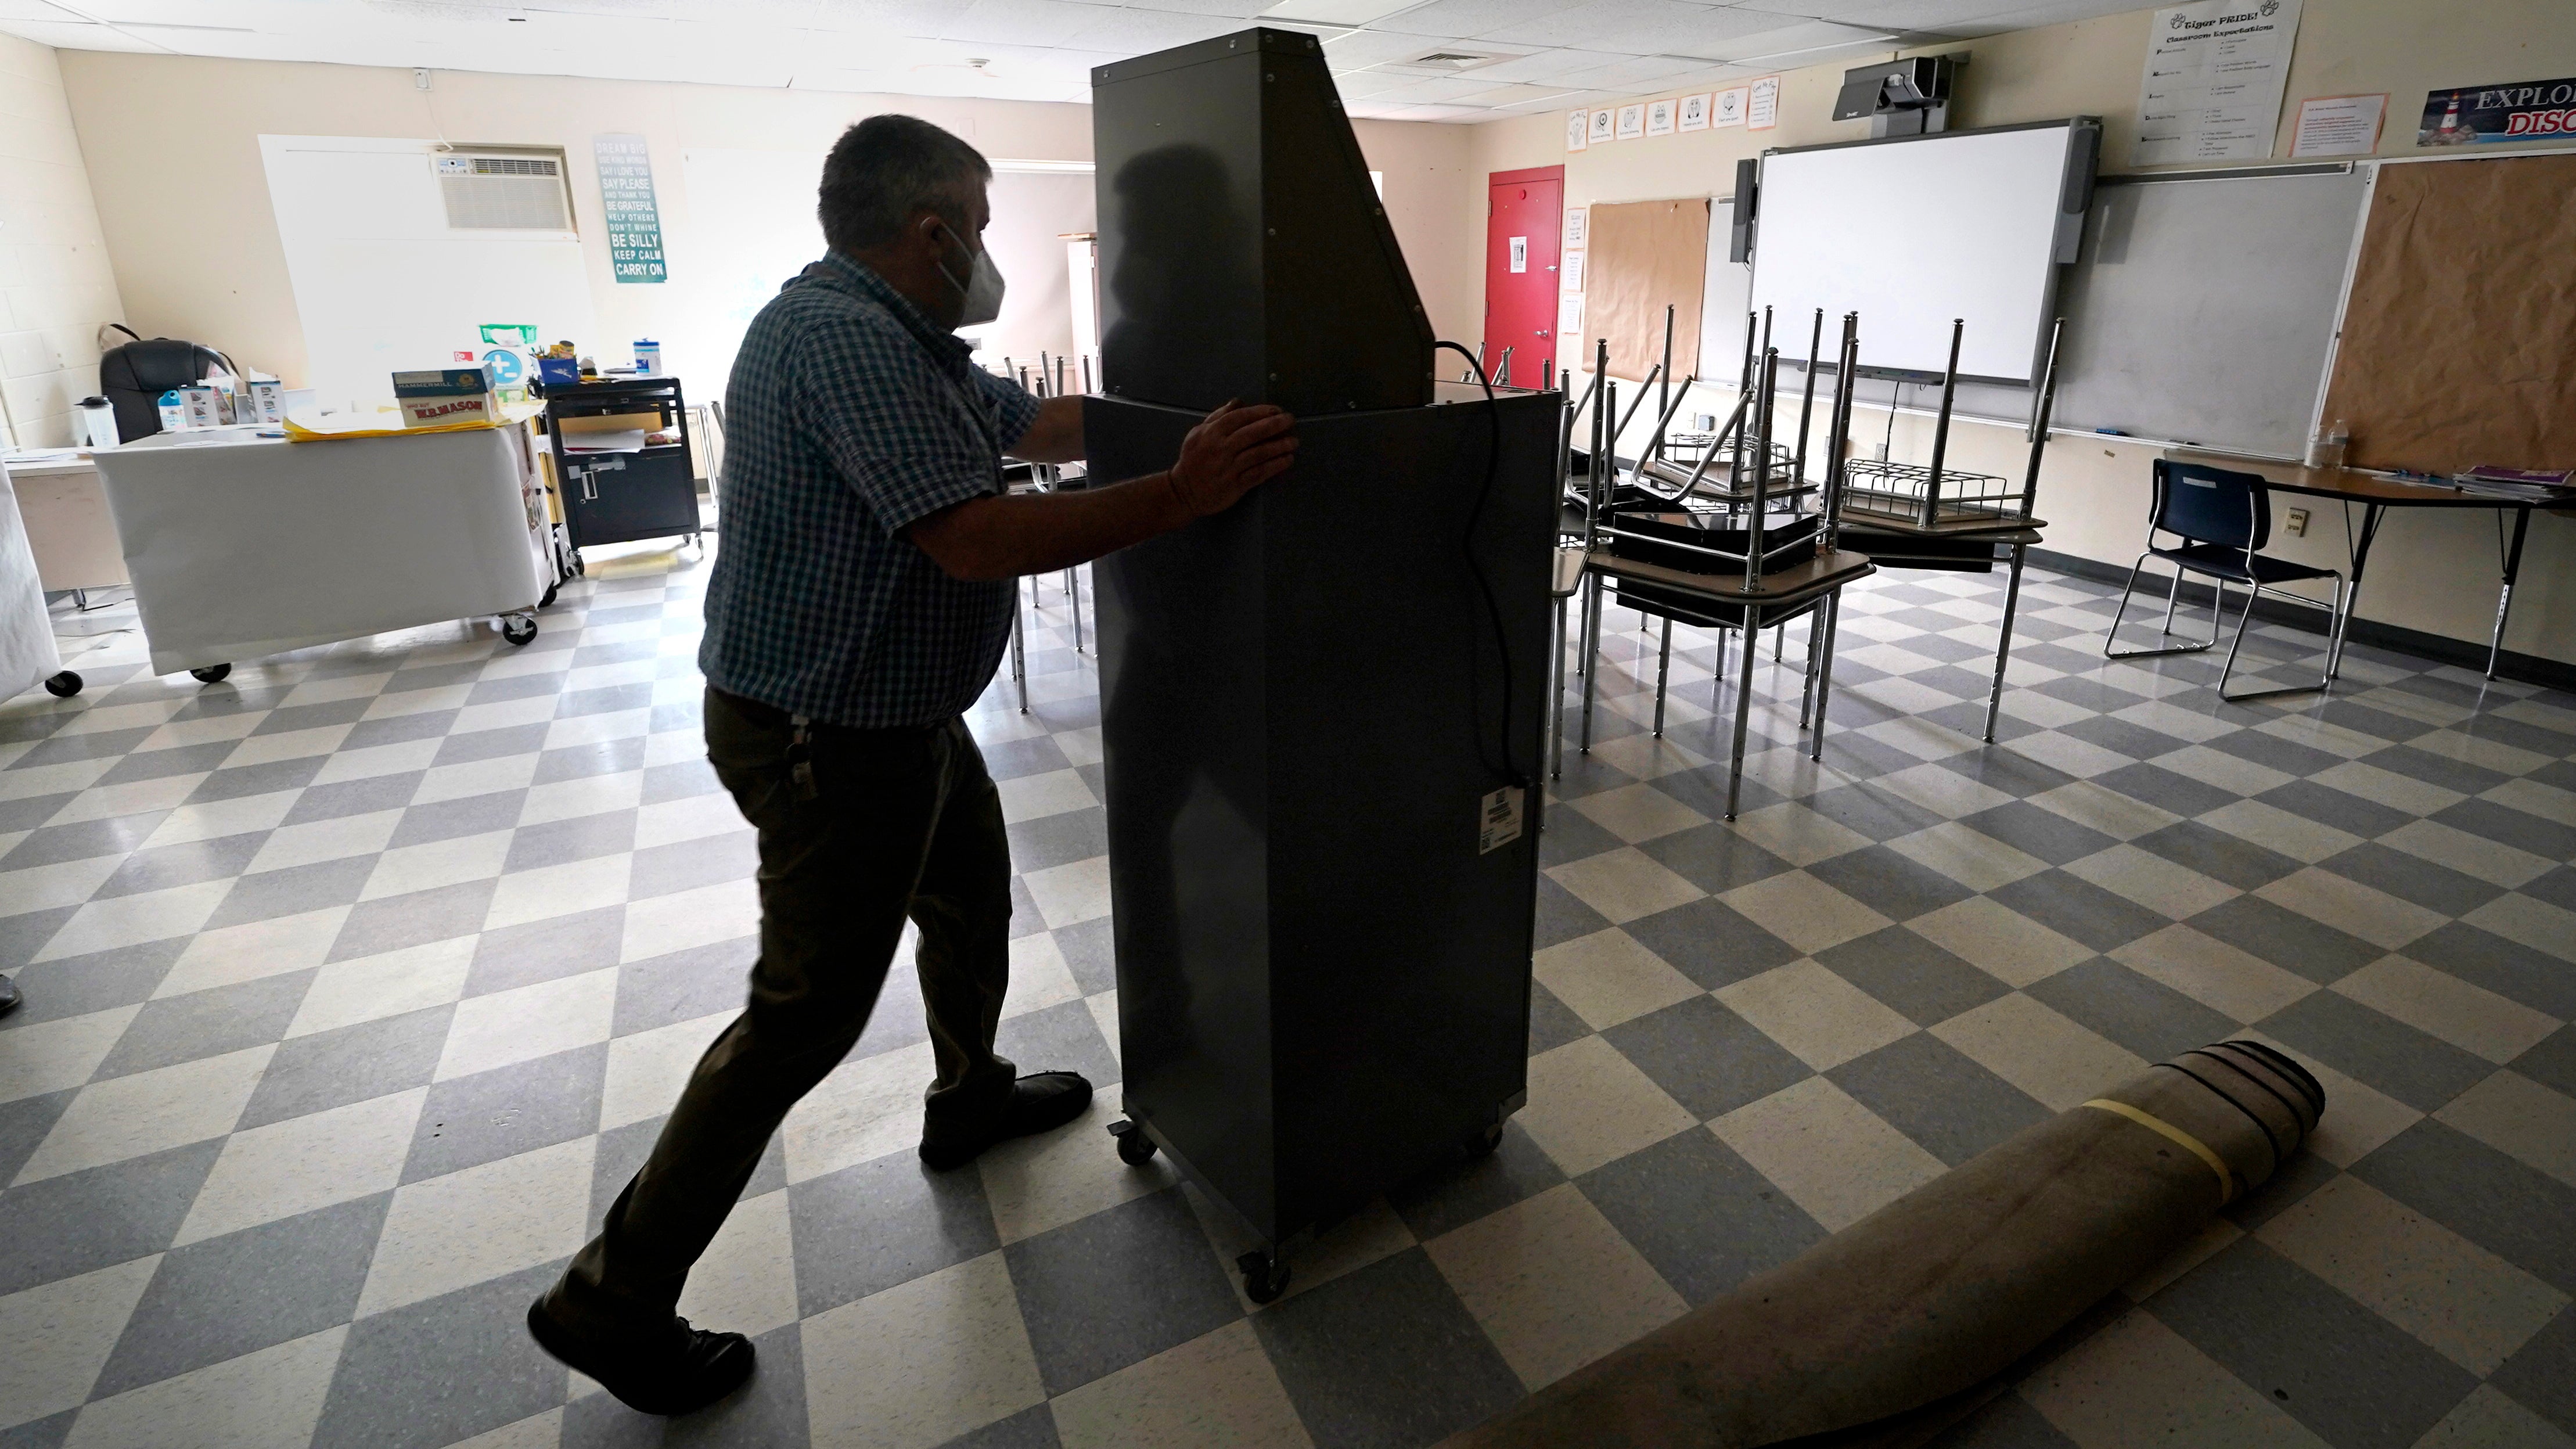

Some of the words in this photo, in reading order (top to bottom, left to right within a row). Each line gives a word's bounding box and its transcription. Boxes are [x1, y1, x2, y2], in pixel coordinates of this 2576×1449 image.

[2183, 20, 2216, 30] Tiger
[2219, 12, 2258, 26] PRIDE!
[2166, 33, 2211, 44] Classroom
[2213, 24, 2274, 38] Expectations
[596, 143, 627, 153] DREAM
[629, 143, 645, 154] BIG
[600, 166, 613, 175] SAY
[617, 167, 634, 175] LOVE
[634, 167, 648, 176] YOU
[602, 178, 618, 189] SAY
[619, 178, 650, 189] PLEASE
[606, 201, 617, 211] BE
[617, 201, 654, 211] GRATEFUL
[607, 213, 625, 221] HELP
[628, 213, 655, 221] OTHERS
[609, 223, 632, 231] DON'T
[634, 223, 657, 231] WHINE
[611, 233, 627, 247] BE
[629, 233, 658, 247] SILLY
[614, 250, 636, 260] KEEP
[639, 250, 661, 260] CALM
[616, 263, 647, 276] CARRY
[649, 263, 664, 276] ON
